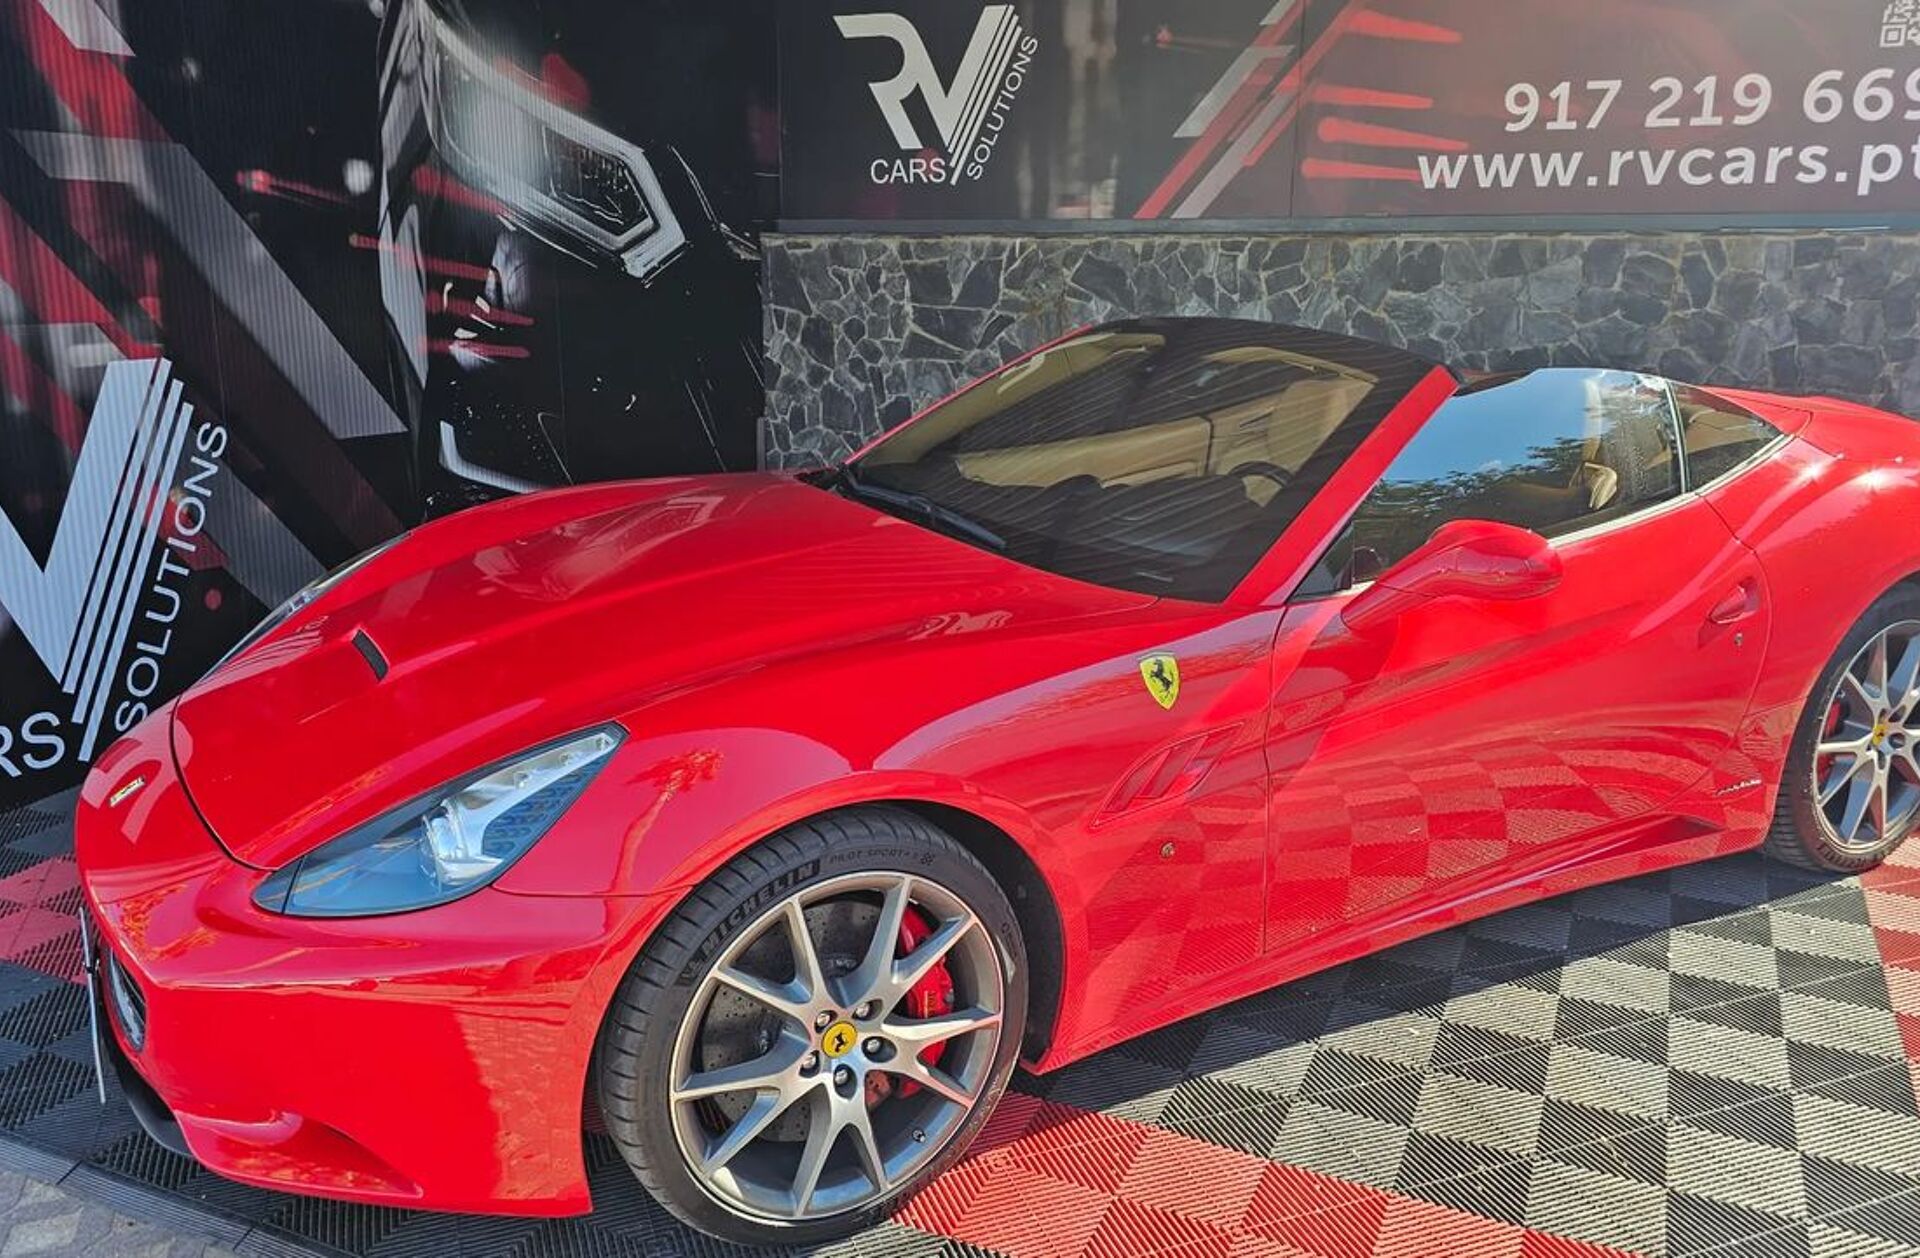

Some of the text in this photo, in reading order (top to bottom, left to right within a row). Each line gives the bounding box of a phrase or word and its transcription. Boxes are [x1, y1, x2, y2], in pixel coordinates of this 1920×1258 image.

[833, 5, 1022, 186] RV
[967, 35, 1039, 181] SOLUTIONS
[1503, 79, 1623, 132] 917
[1644, 72, 1773, 128] 219
[870, 157, 946, 184] CARS
[115, 421, 228, 732] SOLUTIONS
[700, 861, 819, 959] MICHELIN
